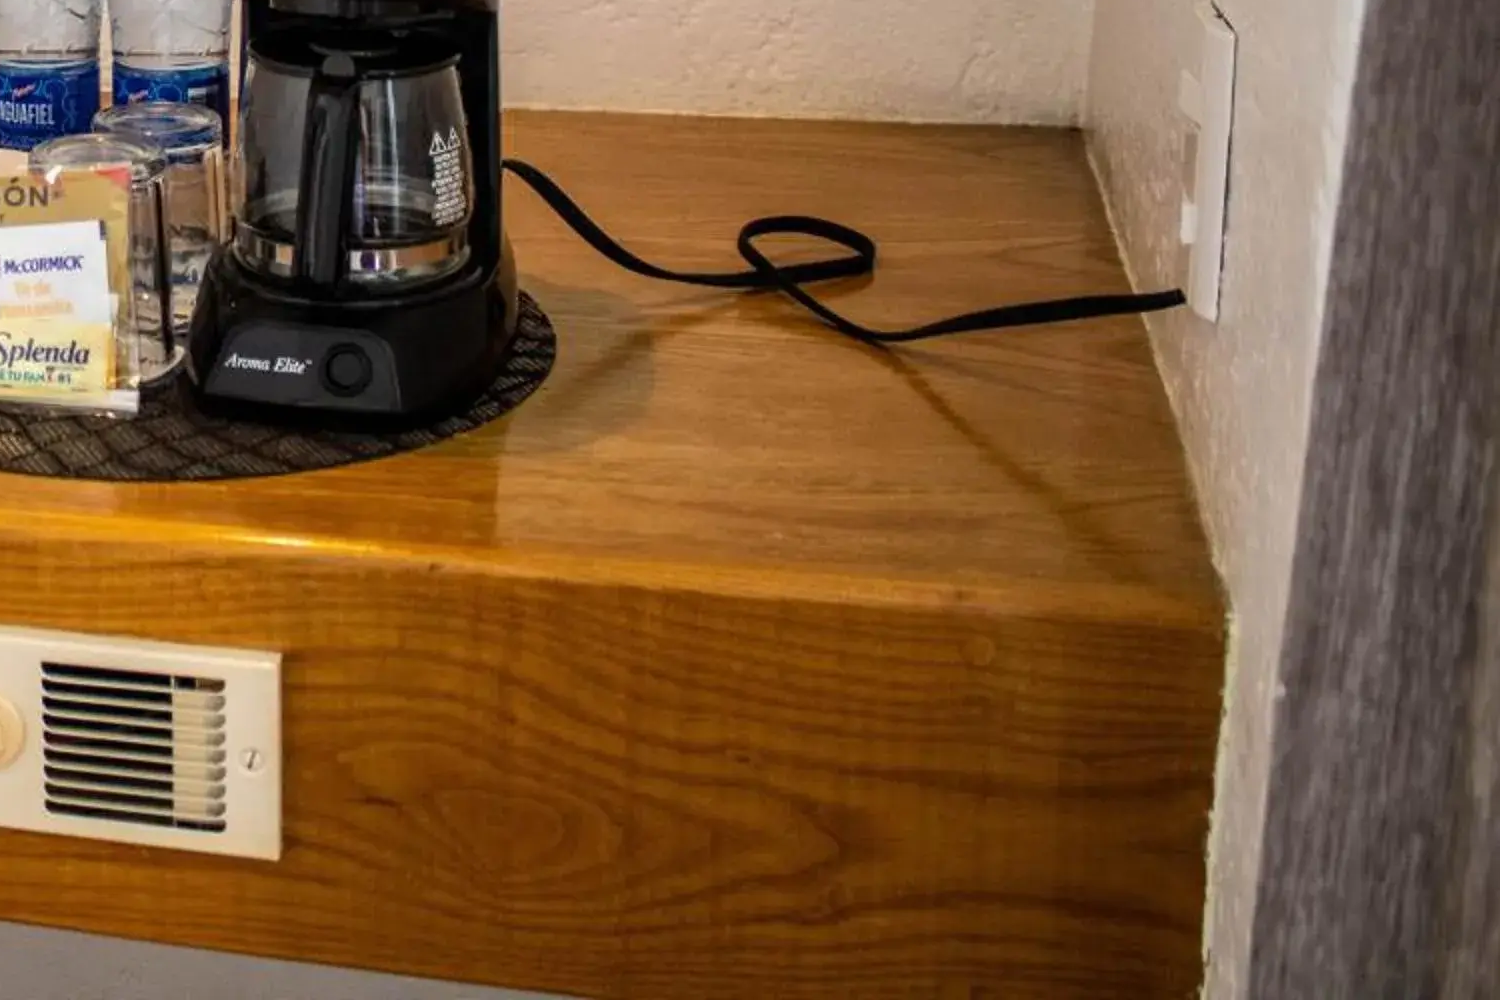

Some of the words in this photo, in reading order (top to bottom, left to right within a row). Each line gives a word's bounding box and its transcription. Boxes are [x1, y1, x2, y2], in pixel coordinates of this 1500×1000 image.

[3, 255, 84, 274] McCORMICK
[224, 353, 270, 371] Aroma
[274, 356, 307, 375] Elite
